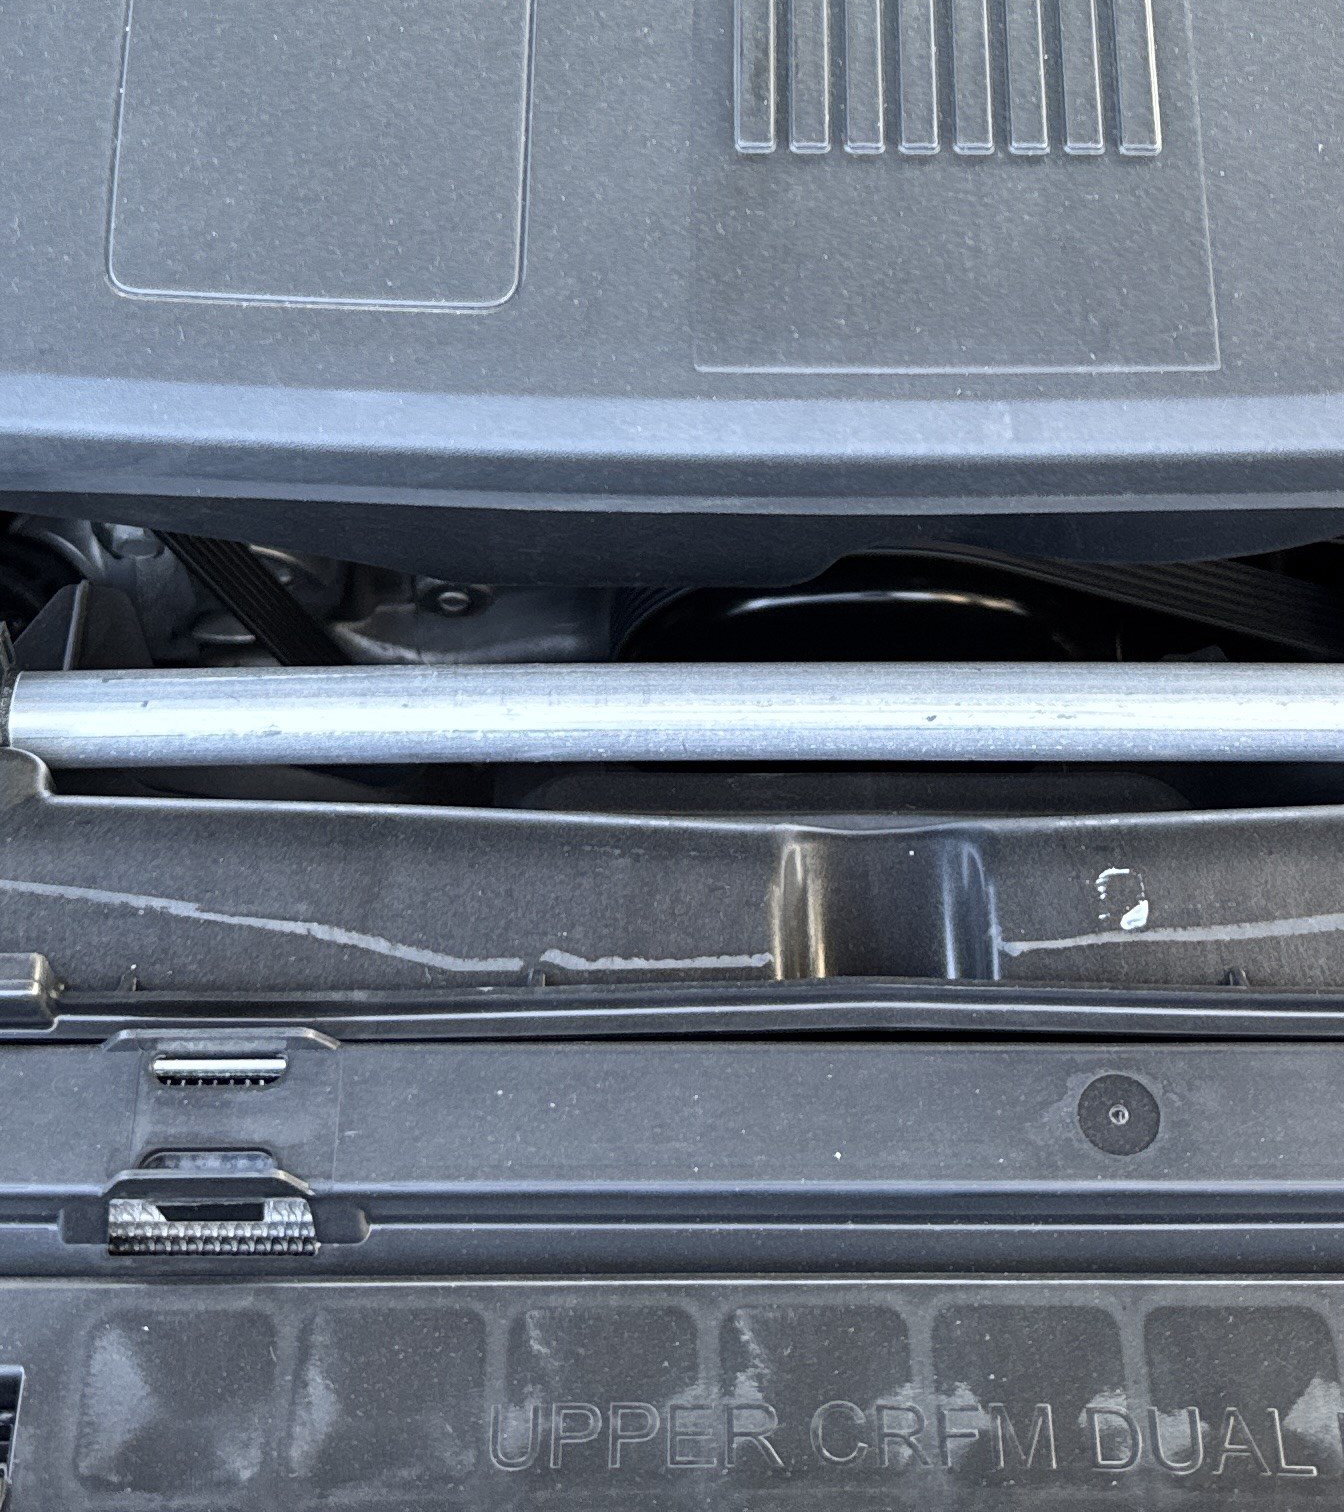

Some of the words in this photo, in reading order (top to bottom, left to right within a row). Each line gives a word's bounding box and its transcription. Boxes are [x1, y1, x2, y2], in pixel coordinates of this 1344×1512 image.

[488, 1400, 786, 1472] UPPER
[809, 1399, 1058, 1471] CRFM
[1085, 1404, 1318, 1478] DUAL
